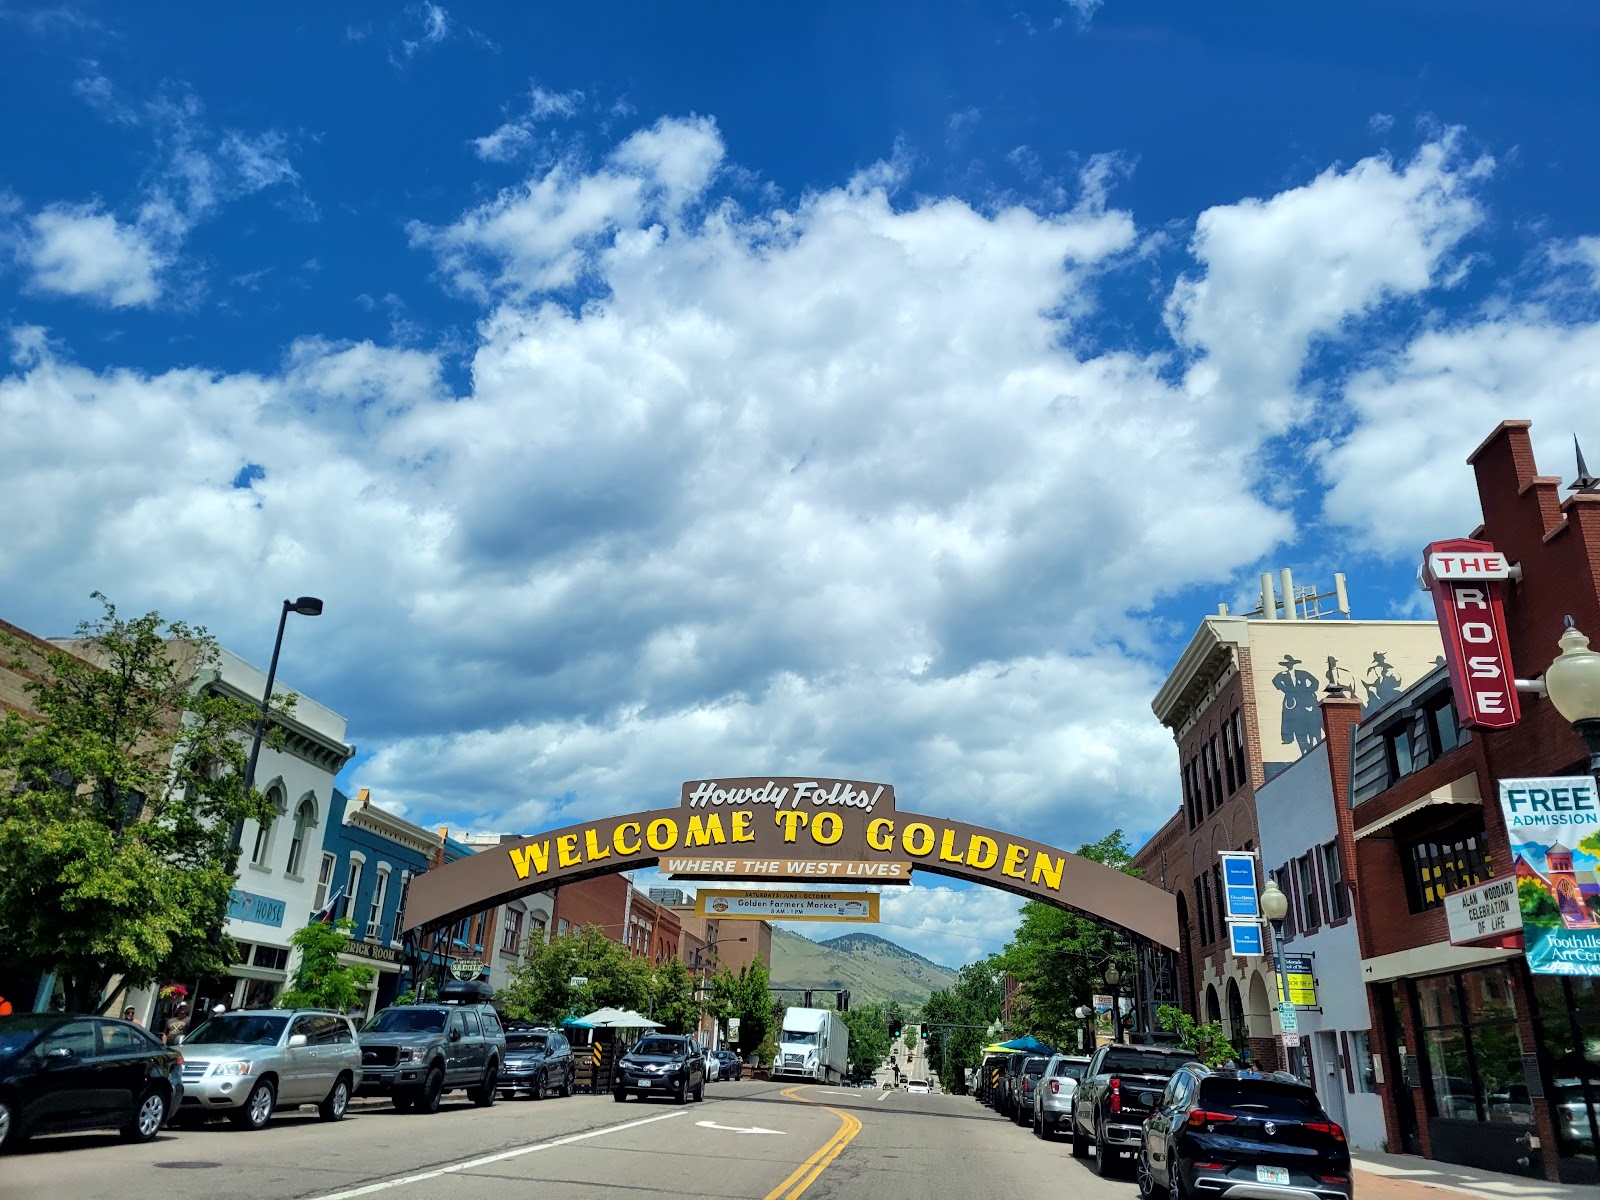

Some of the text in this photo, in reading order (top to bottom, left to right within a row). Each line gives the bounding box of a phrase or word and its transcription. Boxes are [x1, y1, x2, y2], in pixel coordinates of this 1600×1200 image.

[1436, 557, 1502, 574] THE
[1455, 588, 1506, 714] ROSE
[689, 780, 885, 813] Howdy Folks!
[1507, 787, 1595, 813] FREE
[1513, 813, 1598, 826] ADMISSION
[508, 810, 1066, 891] WELCOME TO GOLDEN
[668, 859, 901, 876] WHERE THE WEST LIVES
[738, 899, 768, 907] Golden
[770, 900, 804, 908] Farmers
[806, 901, 837, 909] Market
[1462, 893, 1478, 909] ALAN
[255, 900, 282, 922] HORSE
[1468, 900, 1510, 921] CELEBRATION
[1477, 916, 1505, 934] OF LIFE
[1546, 934, 1600, 948] Foothills
[371, 945, 395, 960] ROOM
[1552, 947, 1574, 960] Art
